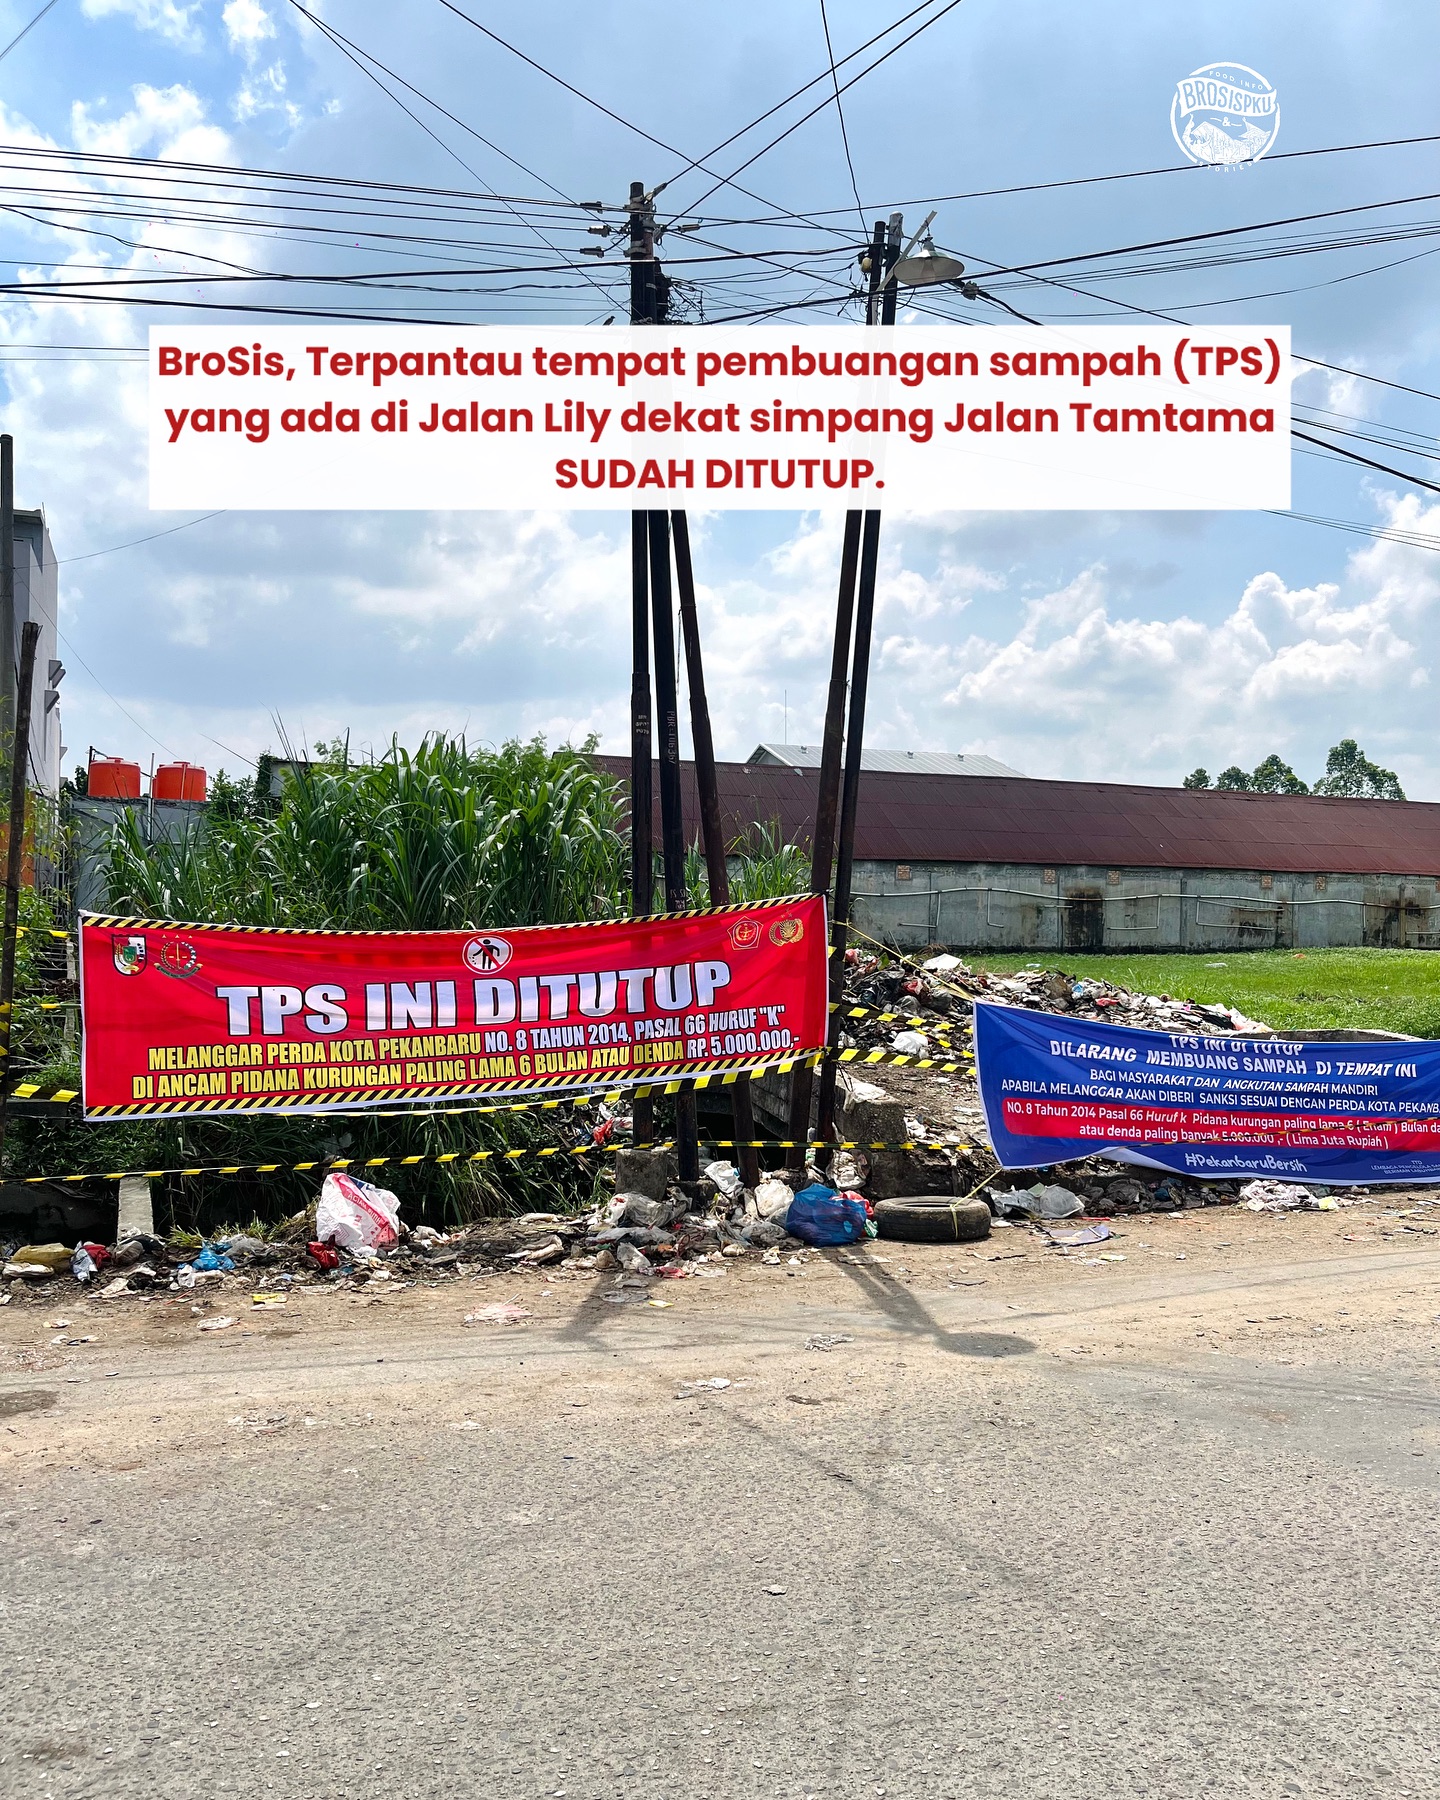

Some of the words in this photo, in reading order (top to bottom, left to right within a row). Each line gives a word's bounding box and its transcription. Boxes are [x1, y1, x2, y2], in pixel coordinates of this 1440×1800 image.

[215, 982, 348, 1036] TPS
[364, 979, 456, 1032] INI
[473, 959, 732, 1026] DITUTUP
[148, 1043, 263, 1071] MELANGGAR
[267, 1041, 326, 1065] PERDA
[329, 1038, 376, 1064] KOTA
[379, 1032, 481, 1060] PEKANBARU
[484, 1030, 513, 1053] NO.
[515, 1029, 528, 1051] 8
[530, 1025, 585, 1050] TAHUN
[588, 1022, 632, 1044] 2014,
[634, 1017, 682, 1040] PASAL
[684, 1013, 706, 1036] 66
[708, 1006, 757, 1032] HURUF
[759, 1004, 785, 1026] "K"
[1168, 1034, 1199, 1050] TPS
[1203, 1038, 1227, 1052] INI
[132, 1075, 154, 1099] DI
[157, 1071, 227, 1098] ANCAM
[230, 1068, 300, 1094] PIDANA
[303, 1064, 402, 1090] KURUNGAN
[405, 1060, 466, 1084] PALING
[469, 1056, 517, 1080] LAMA
[519, 1054, 531, 1076] 6
[534, 1050, 588, 1075] BULAN
[590, 1046, 630, 1069] ATAU
[633, 1041, 684, 1065] DENDA
[686, 1037, 709, 1059] RP.
[710, 1028, 800, 1057] 5.000.000,-
[1050, 1040, 1137, 1062] DILARANG
[1146, 1049, 1239, 1071] MEMBUANG
[1243, 1057, 1307, 1075] SAMPAH
[1316, 1060, 1332, 1076] DI
[1336, 1061, 1394, 1077] TEMPAT
[1394, 1063, 1417, 1078] INI
[1001, 1078, 1047, 1093] APABILA
[1050, 1082, 1124, 1099] MELANGGAR
[1125, 1088, 1156, 1101] AKAN
[1158, 1091, 1195, 1103] DIBERI
[1199, 1092, 1237, 1106] SANKSI
[1240, 1094, 1278, 1107] SESUAI
[1280, 1097, 1326, 1110] DENGAN
[1328, 1098, 1366, 1111] PERDA
[1367, 1100, 1397, 1113] KOTA
[1398, 1101, 1440, 1114] PEKANB
[1090, 1068, 1116, 1082] BAGI
[1118, 1071, 1194, 1086] MASYARAKAT
[1194, 1076, 1220, 1088] DAN
[1223, 1079, 1284, 1092] ANGKUTAN
[1284, 1081, 1329, 1094] SAMPAH
[1331, 1083, 1379, 1096] MANDIRI
[1006, 1101, 1024, 1115] NO.
[1025, 1103, 1033, 1115] 8
[1035, 1103, 1068, 1117] Tahun
[1070, 1105, 1096, 1118] 2014
[1098, 1107, 1127, 1120] Pasal
[1129, 1109, 1144, 1121] 66
[1146, 1110, 1179, 1123] Huruf
[1179, 1112, 1187, 1124] k
[1192, 1112, 1229, 1126] Pidana
[1230, 1114, 1281, 1130] kurungan
[1283, 1117, 1317, 1131] paling
[1318, 1117, 1344, 1131] lama
[1347, 1120, 1354, 1131] 6
[1400, 1121, 1429, 1133] Bulan
[1079, 1124, 1105, 1136] atau
[1106, 1124, 1142, 1138] denda
[1144, 1126, 1178, 1142] paling
[1181, 1128, 1219, 1143] banyak
[1292, 1132, 1319, 1145] Lima
[1320, 1134, 1346, 1146] Juta
[1346, 1134, 1383, 1149] Rupiah
[1184, 1152, 1308, 1173] #PekanbaruBersih
